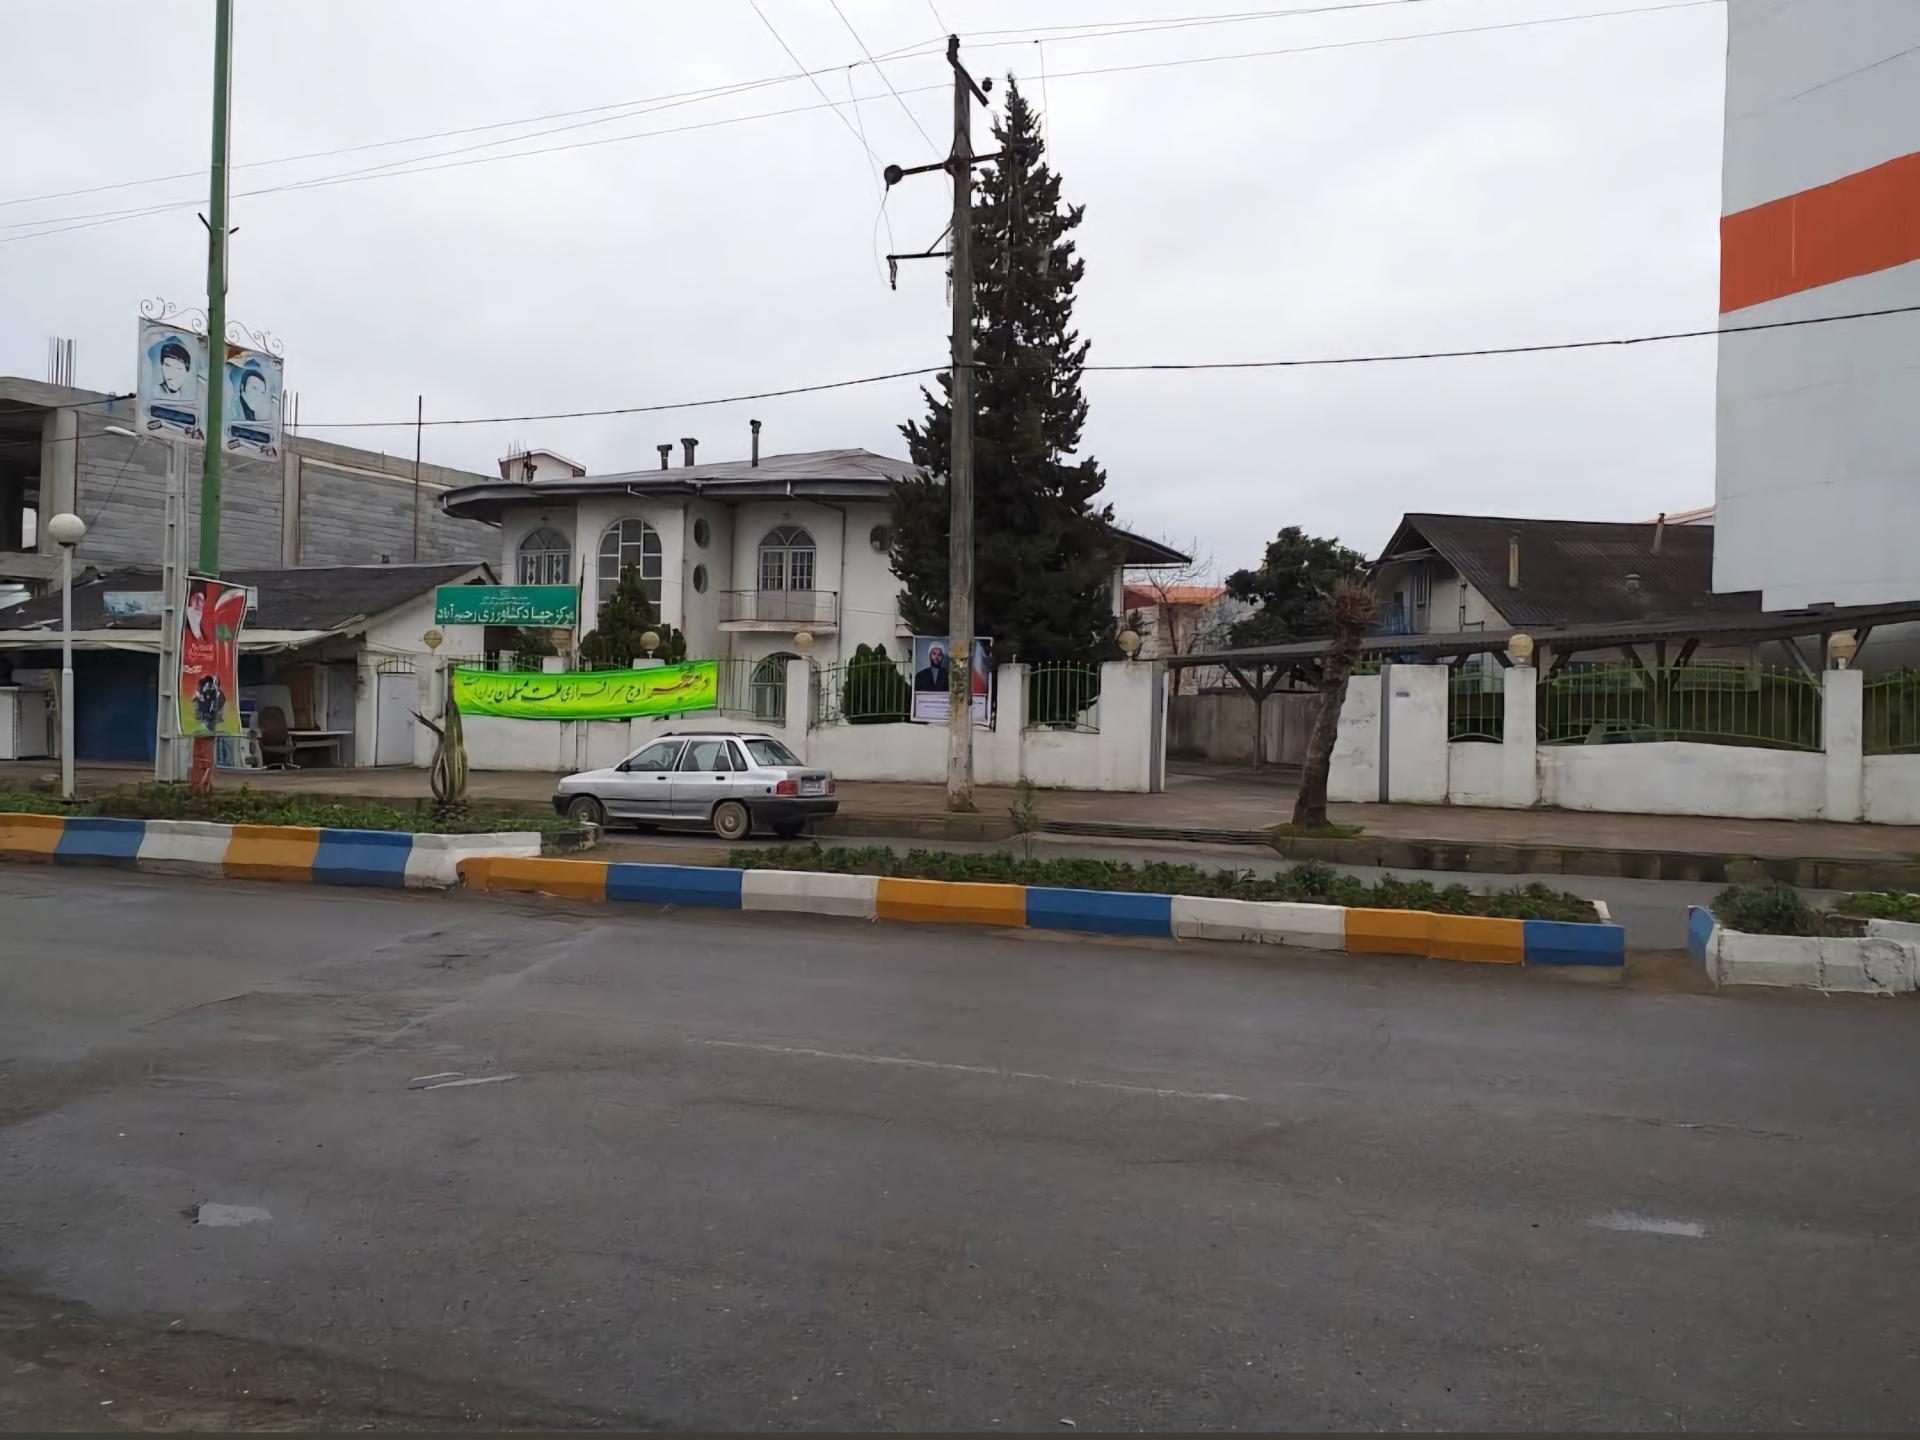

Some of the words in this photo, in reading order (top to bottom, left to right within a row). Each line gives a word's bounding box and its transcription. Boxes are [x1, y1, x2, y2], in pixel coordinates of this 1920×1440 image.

[437, 603, 455, 619] آباد
[454, 610, 477, 622] رحیم
[478, 603, 530, 622] کشاورزی
[521, 606, 554, 623] جهاد
